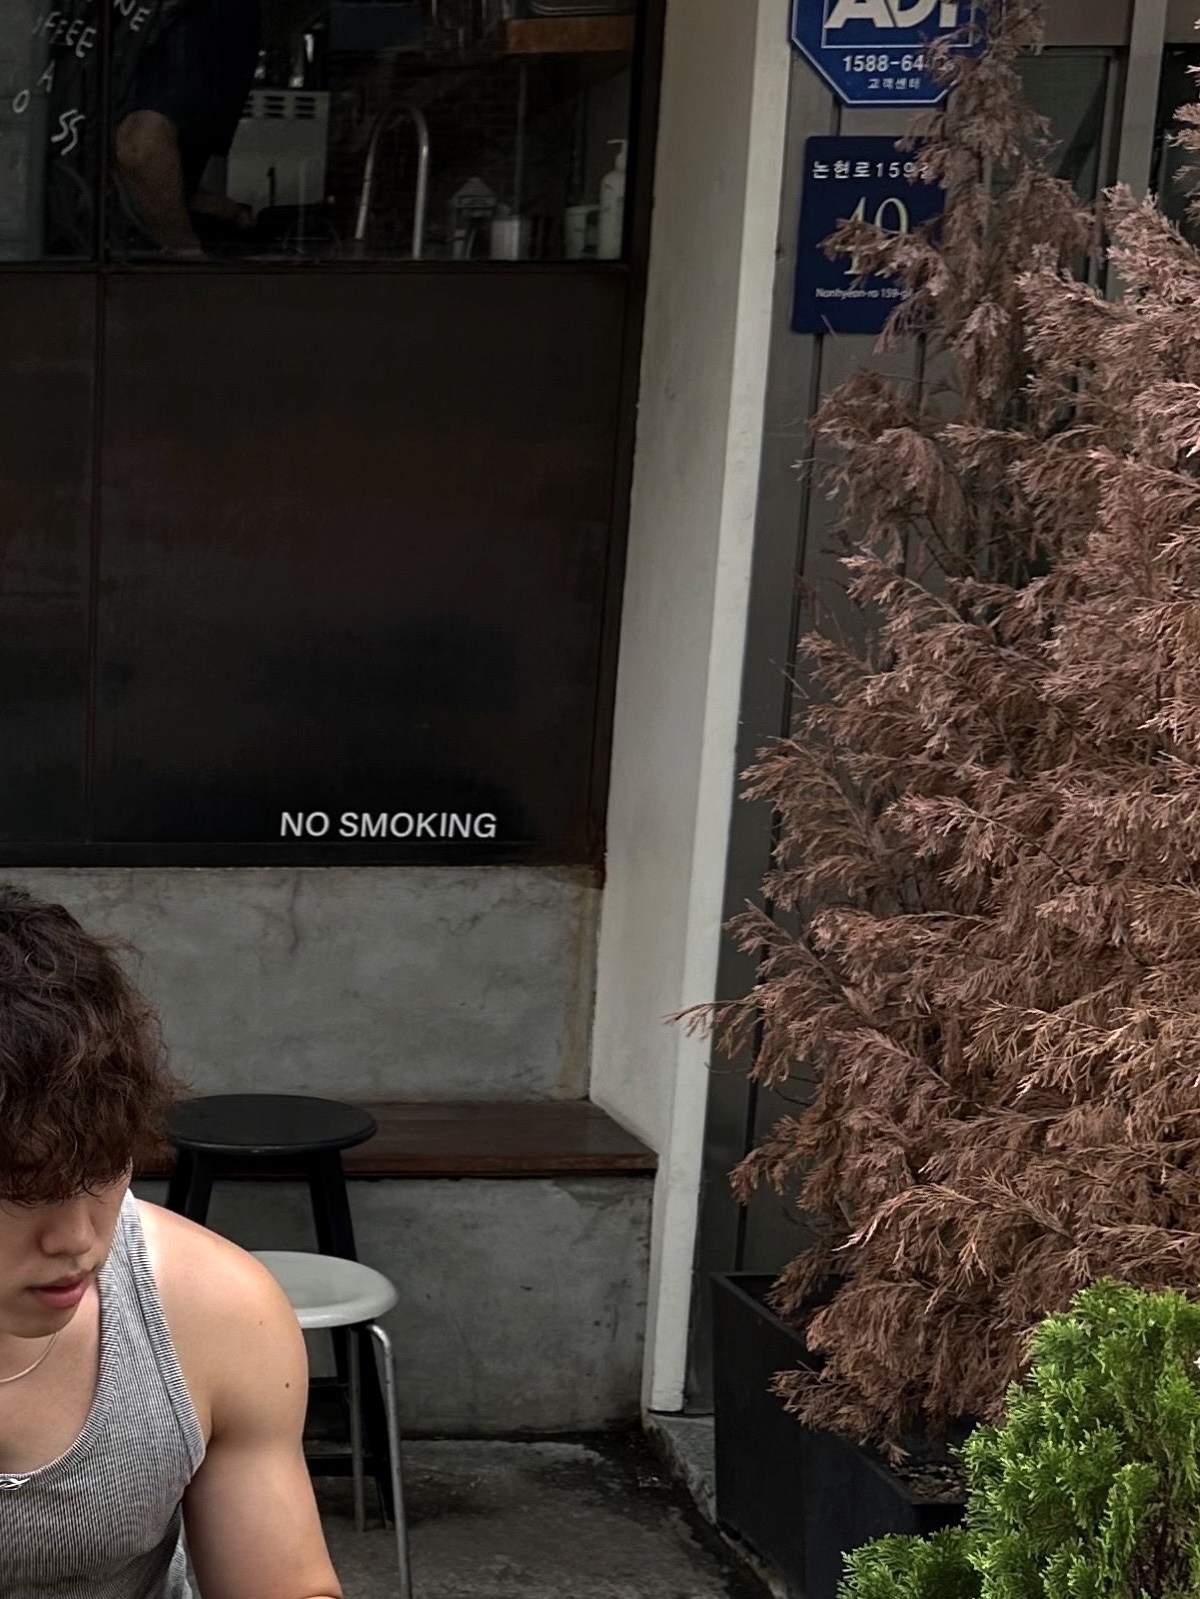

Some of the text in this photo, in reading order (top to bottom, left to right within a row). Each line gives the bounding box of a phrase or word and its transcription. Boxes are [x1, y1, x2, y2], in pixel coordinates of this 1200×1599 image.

[842, 54, 948, 72] 1588-64
[867, 78, 922, 90] 고객센터
[280, 811, 498, 838] NO SMOKING
